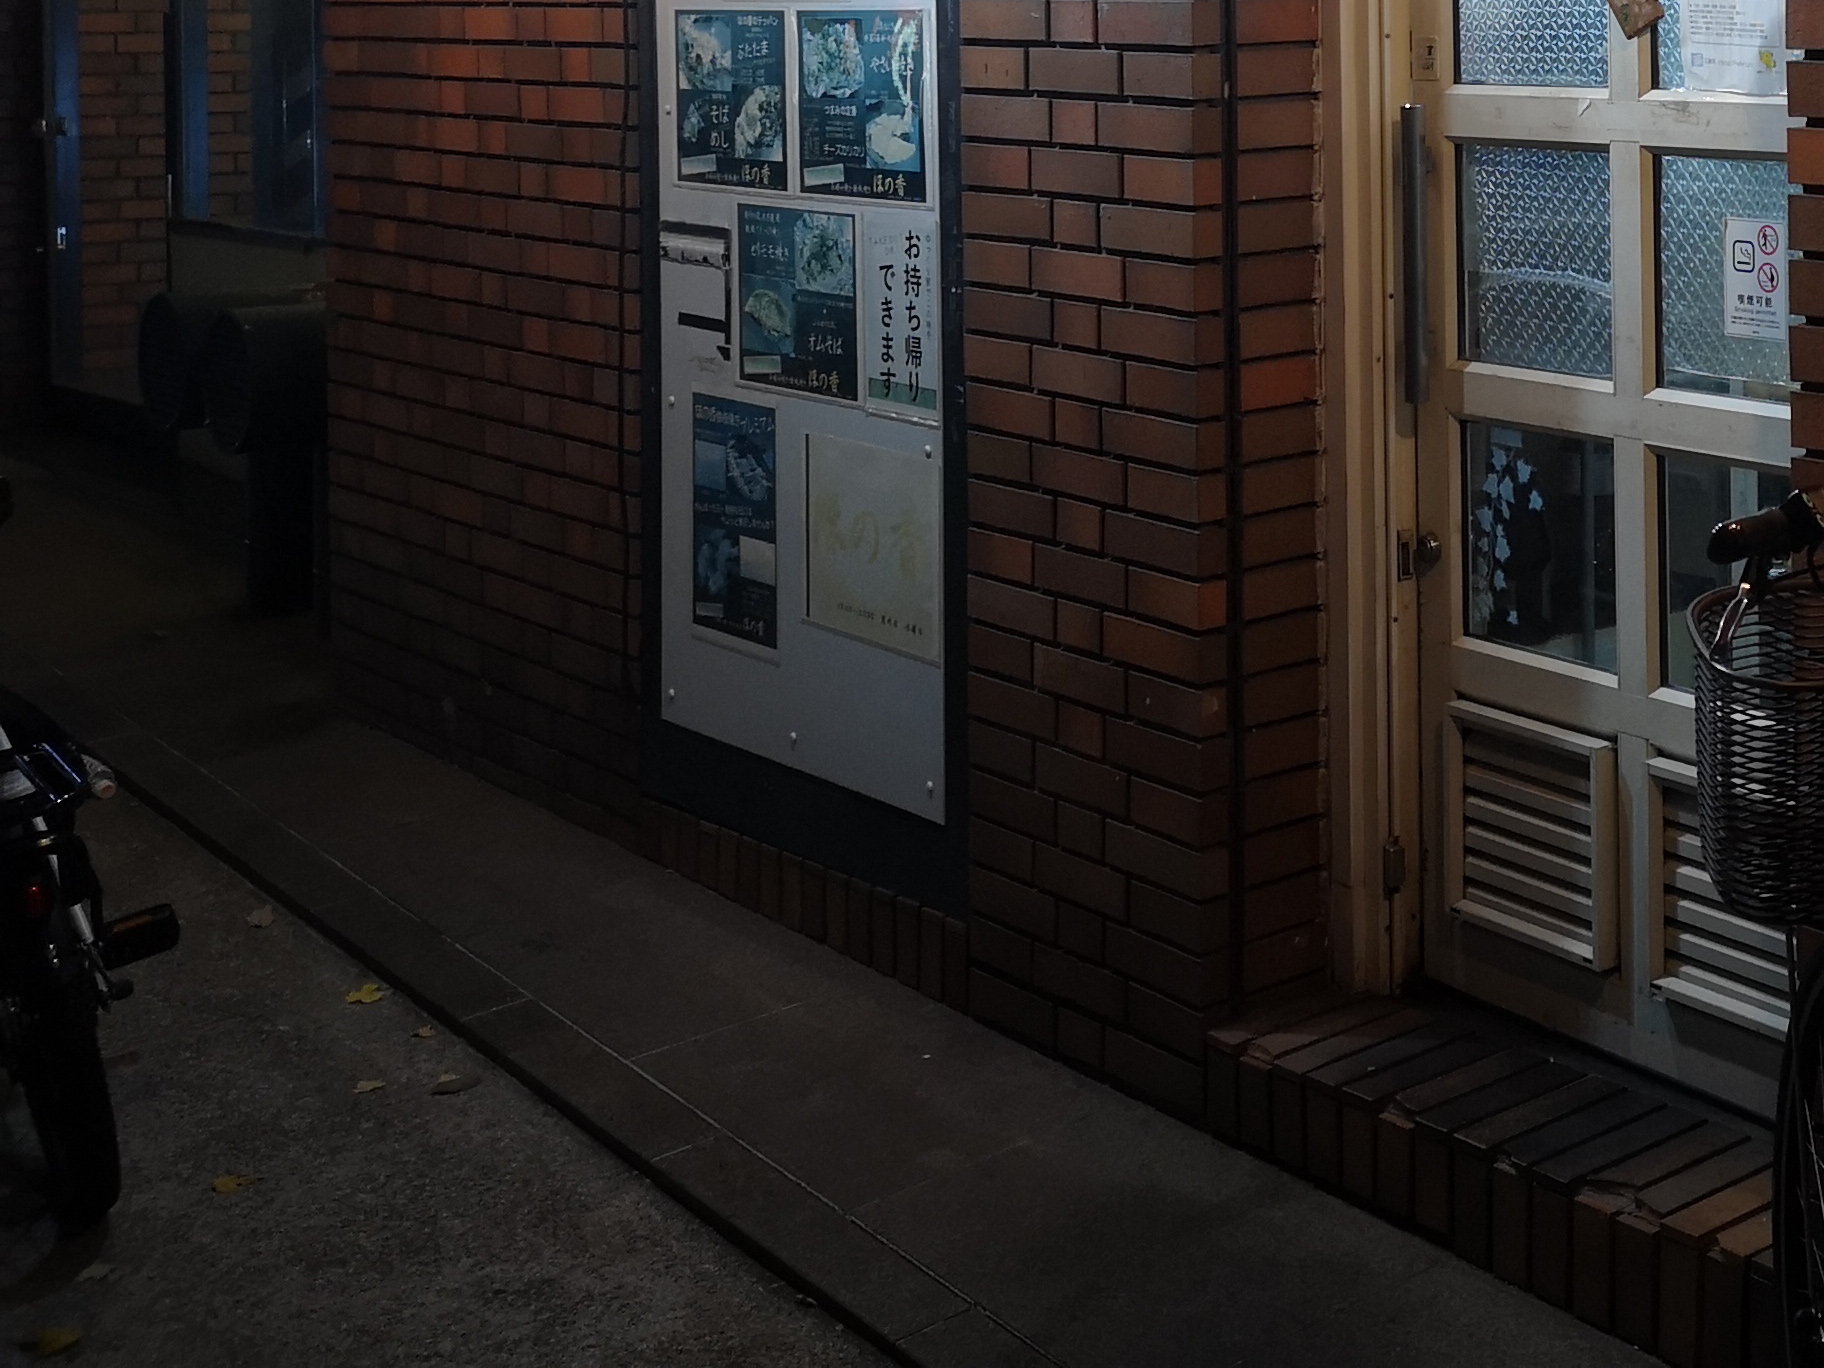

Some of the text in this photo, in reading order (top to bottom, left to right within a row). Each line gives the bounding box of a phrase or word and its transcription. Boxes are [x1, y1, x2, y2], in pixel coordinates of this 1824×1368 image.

[710, 105, 730, 124] そば
[710, 131, 729, 148] めし
[873, 173, 906, 197] ほの香
[1737, 294, 1773, 308] 喫煙可能
[904, 229, 922, 402] お持ち帰り
[879, 264, 896, 398] できます
[808, 333, 844, 355] オムそば
